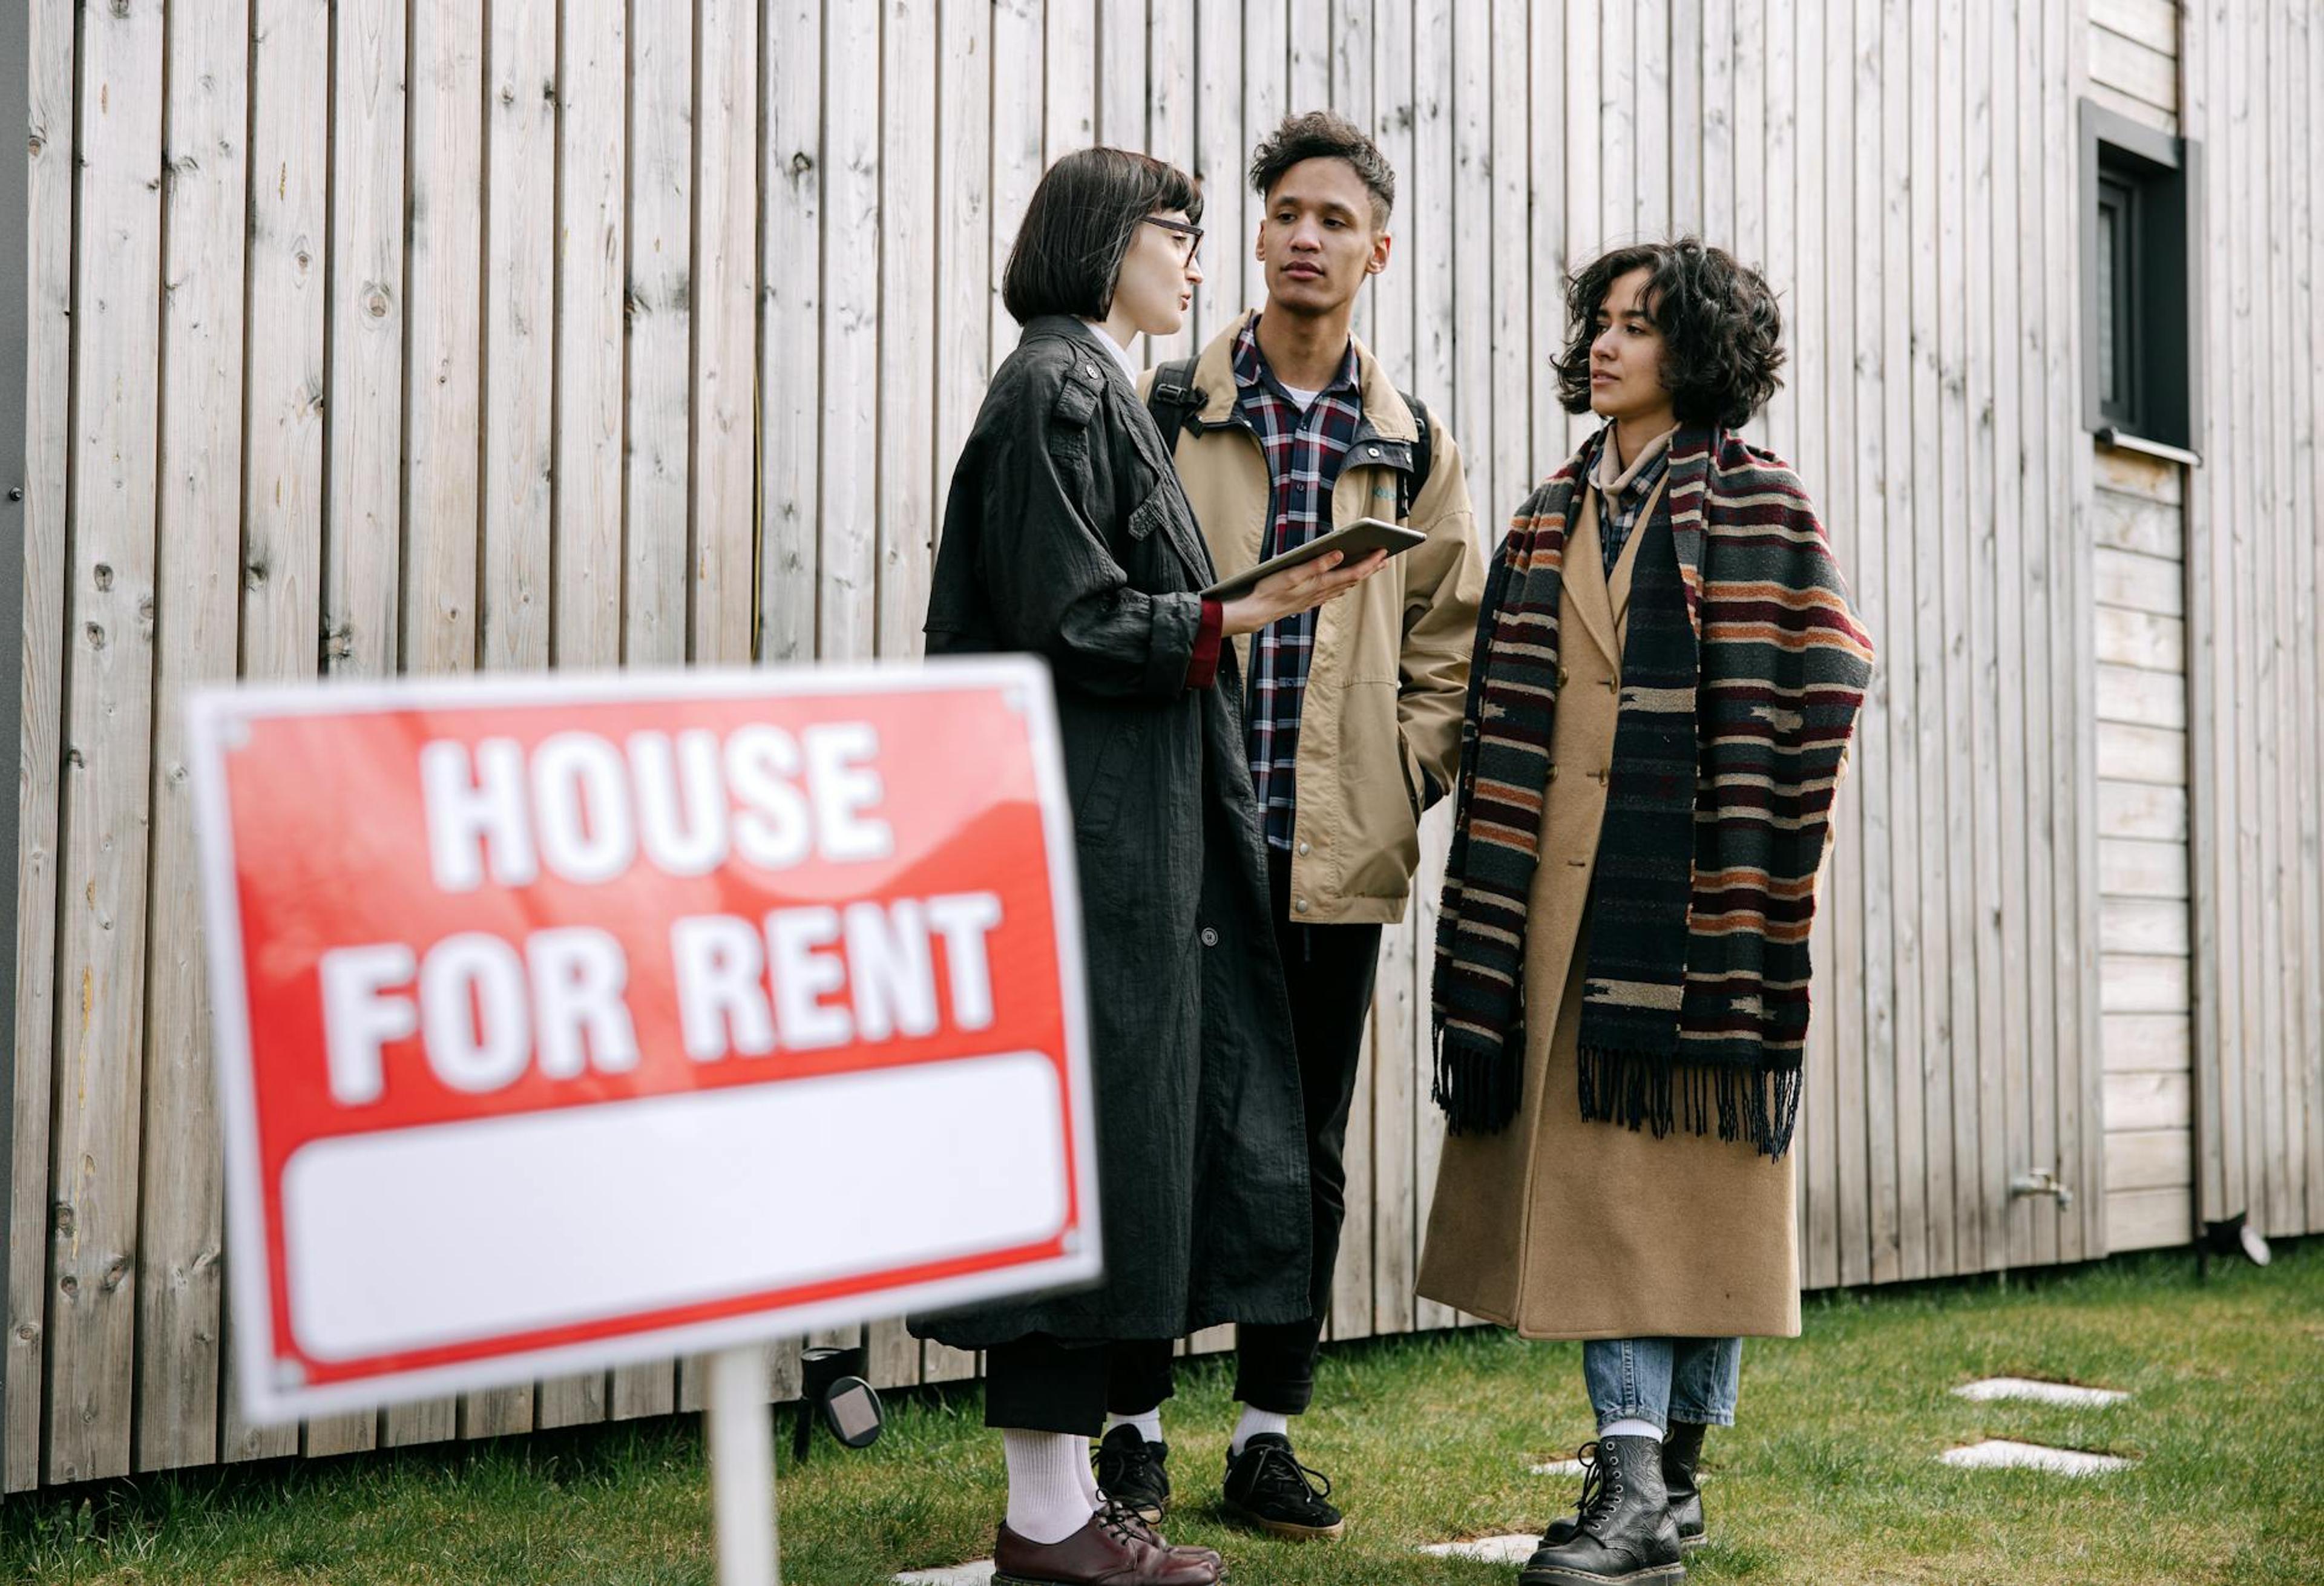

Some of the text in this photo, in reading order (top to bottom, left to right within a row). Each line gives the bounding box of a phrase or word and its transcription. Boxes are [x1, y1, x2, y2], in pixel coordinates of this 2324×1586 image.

[423, 723, 894, 891] HOUSE
[323, 894, 1000, 1104] FOR RENT
